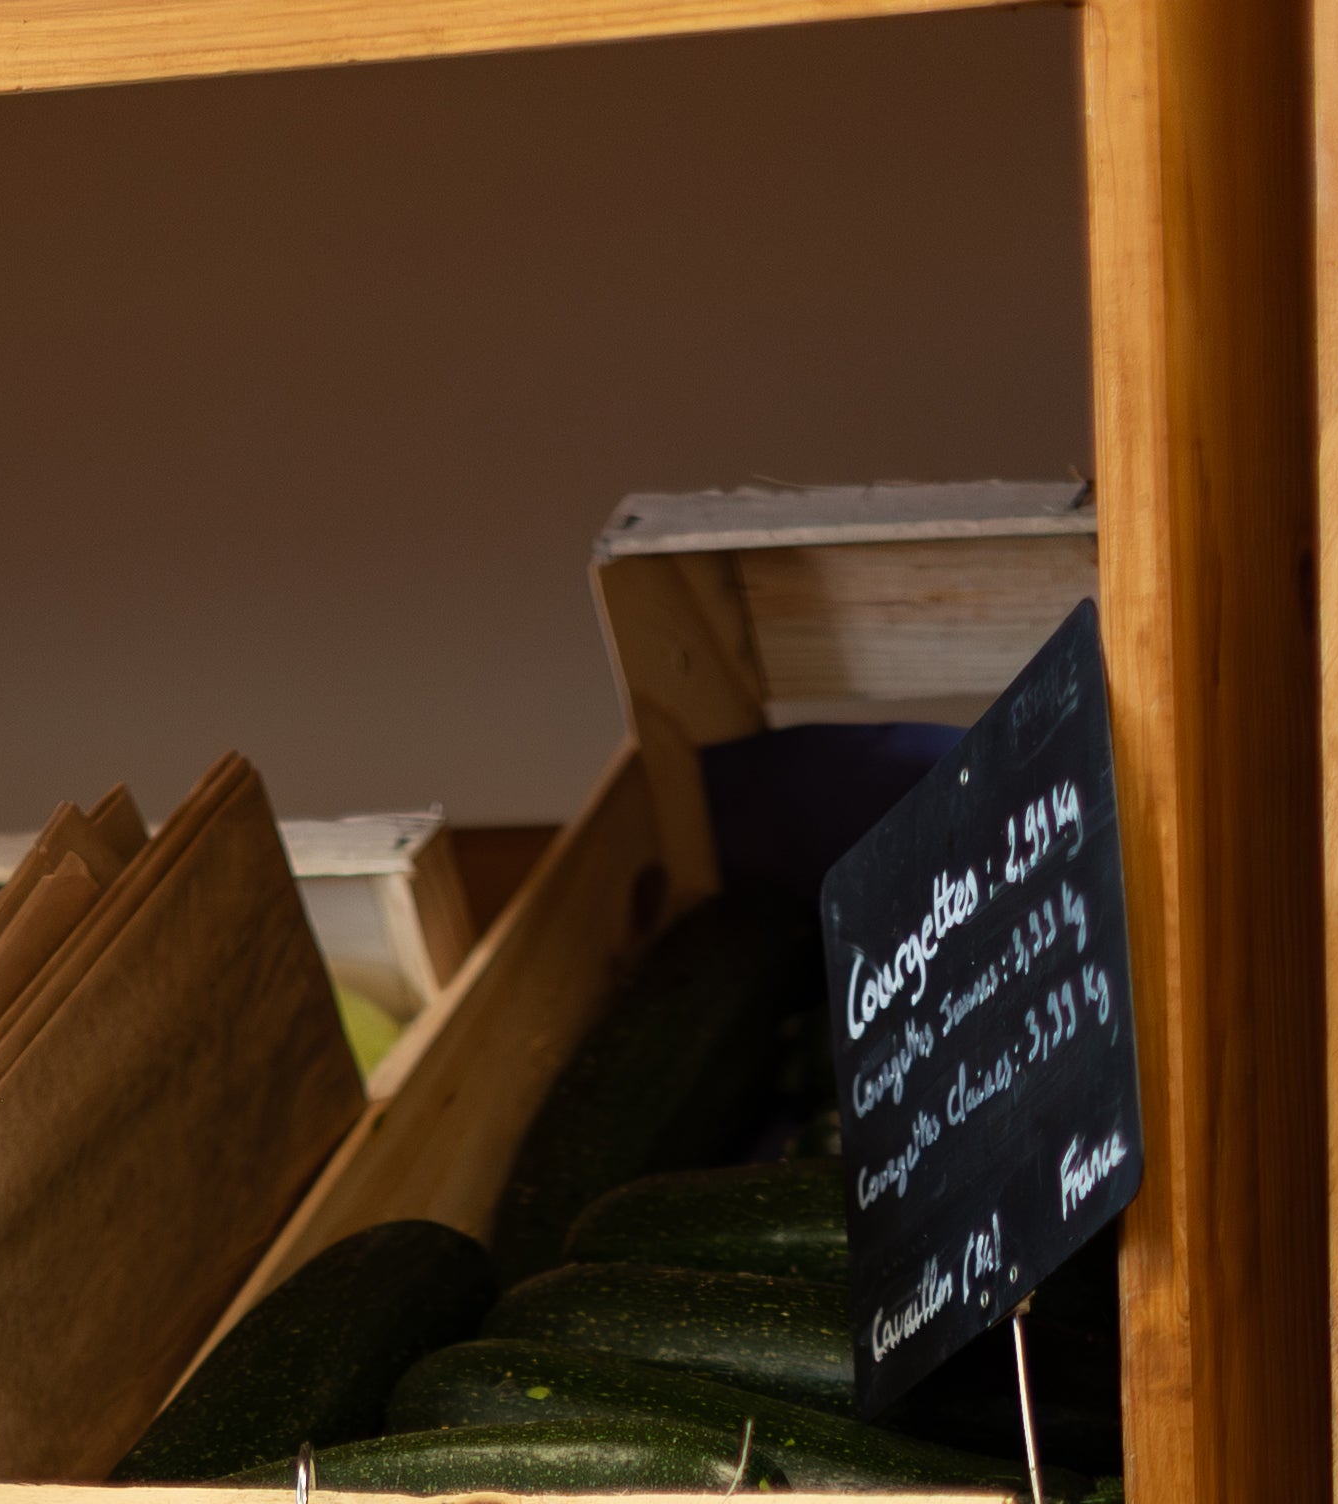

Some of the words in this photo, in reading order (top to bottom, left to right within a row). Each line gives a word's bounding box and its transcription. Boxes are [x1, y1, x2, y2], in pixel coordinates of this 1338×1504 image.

[1006, 796, 1050, 884] 2,99
[853, 1016, 934, 1118] Courgettes
[857, 1110, 941, 1211] Courgettes
[1024, 981, 1077, 1064] 3,99
[1061, 1131, 1127, 1222] France
